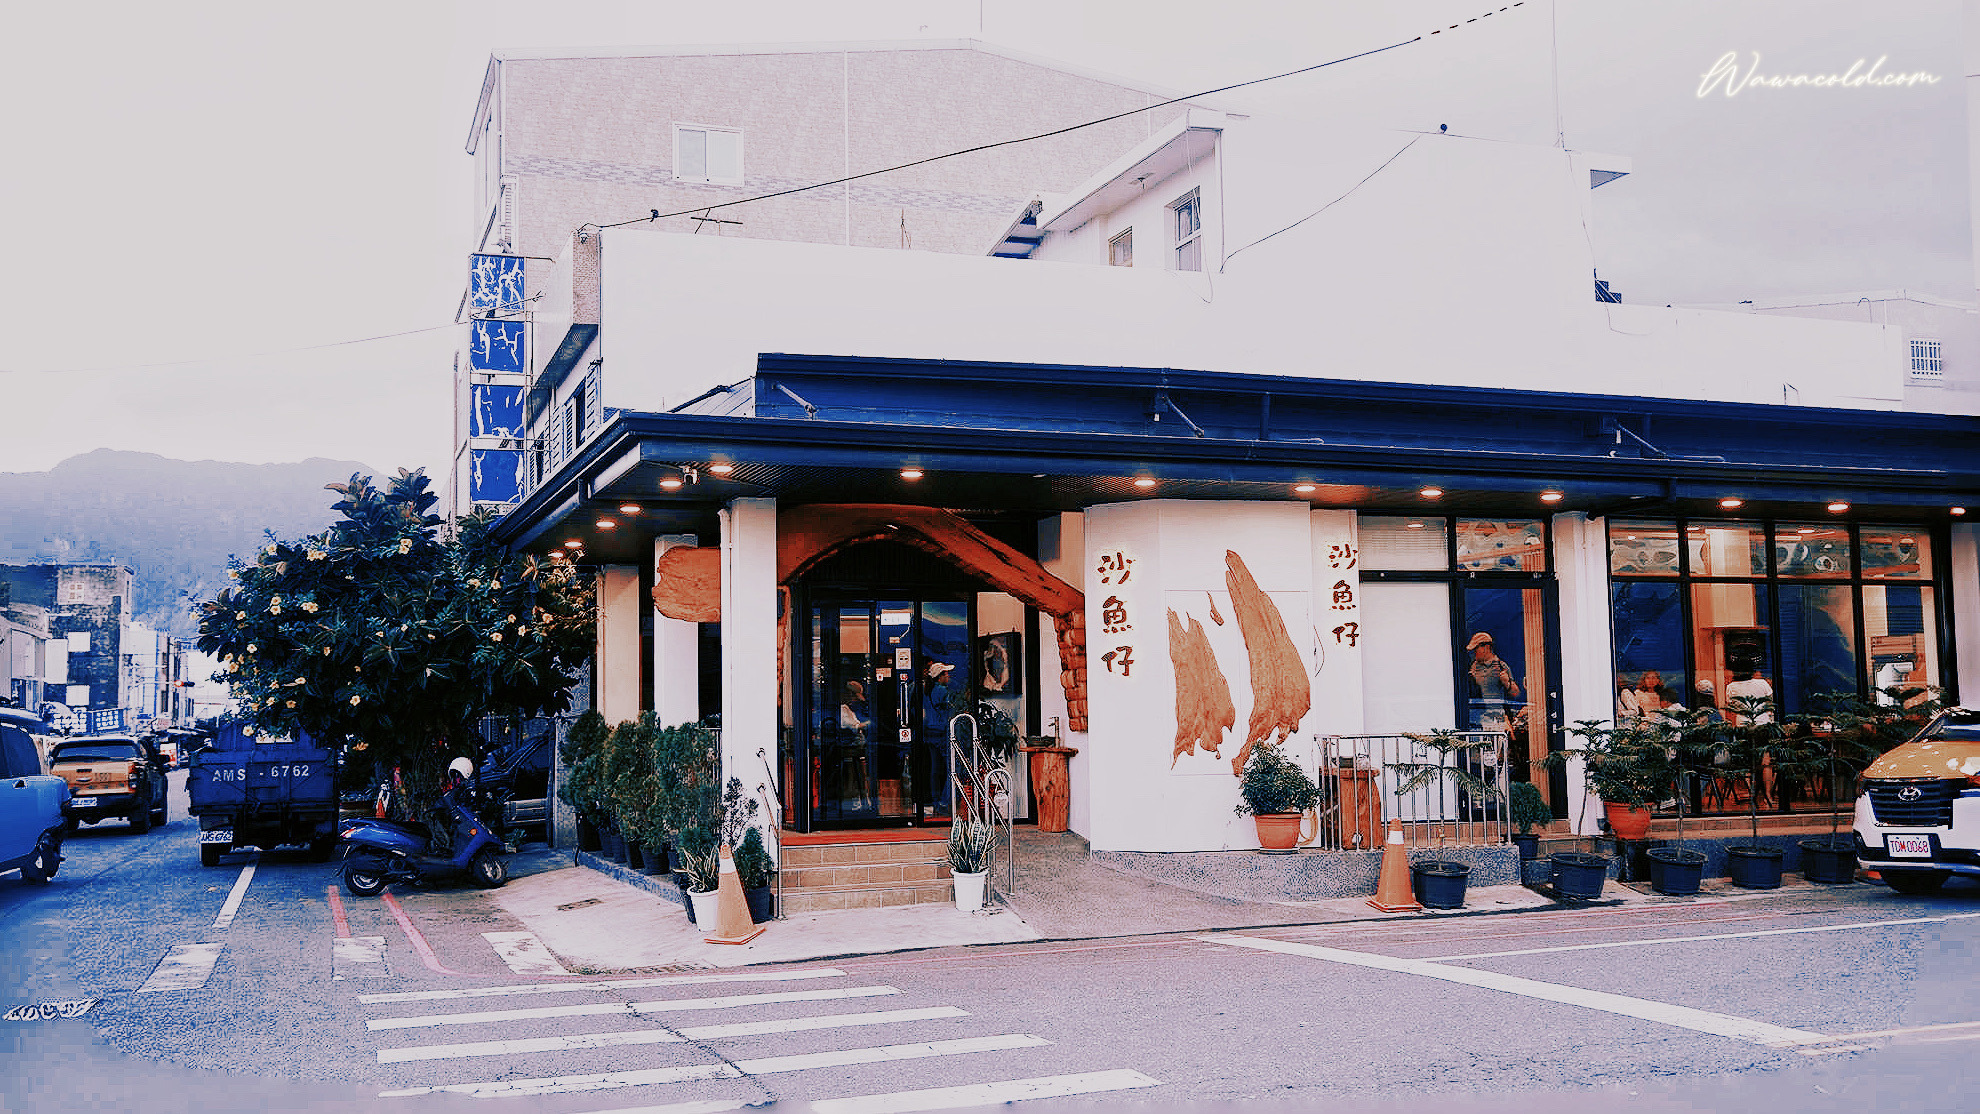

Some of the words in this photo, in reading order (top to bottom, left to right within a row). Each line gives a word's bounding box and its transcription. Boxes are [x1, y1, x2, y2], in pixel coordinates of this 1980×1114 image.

[1097, 551, 1135, 676] 沙魚仔
[1328, 543, 1359, 647] 沙魚仔
